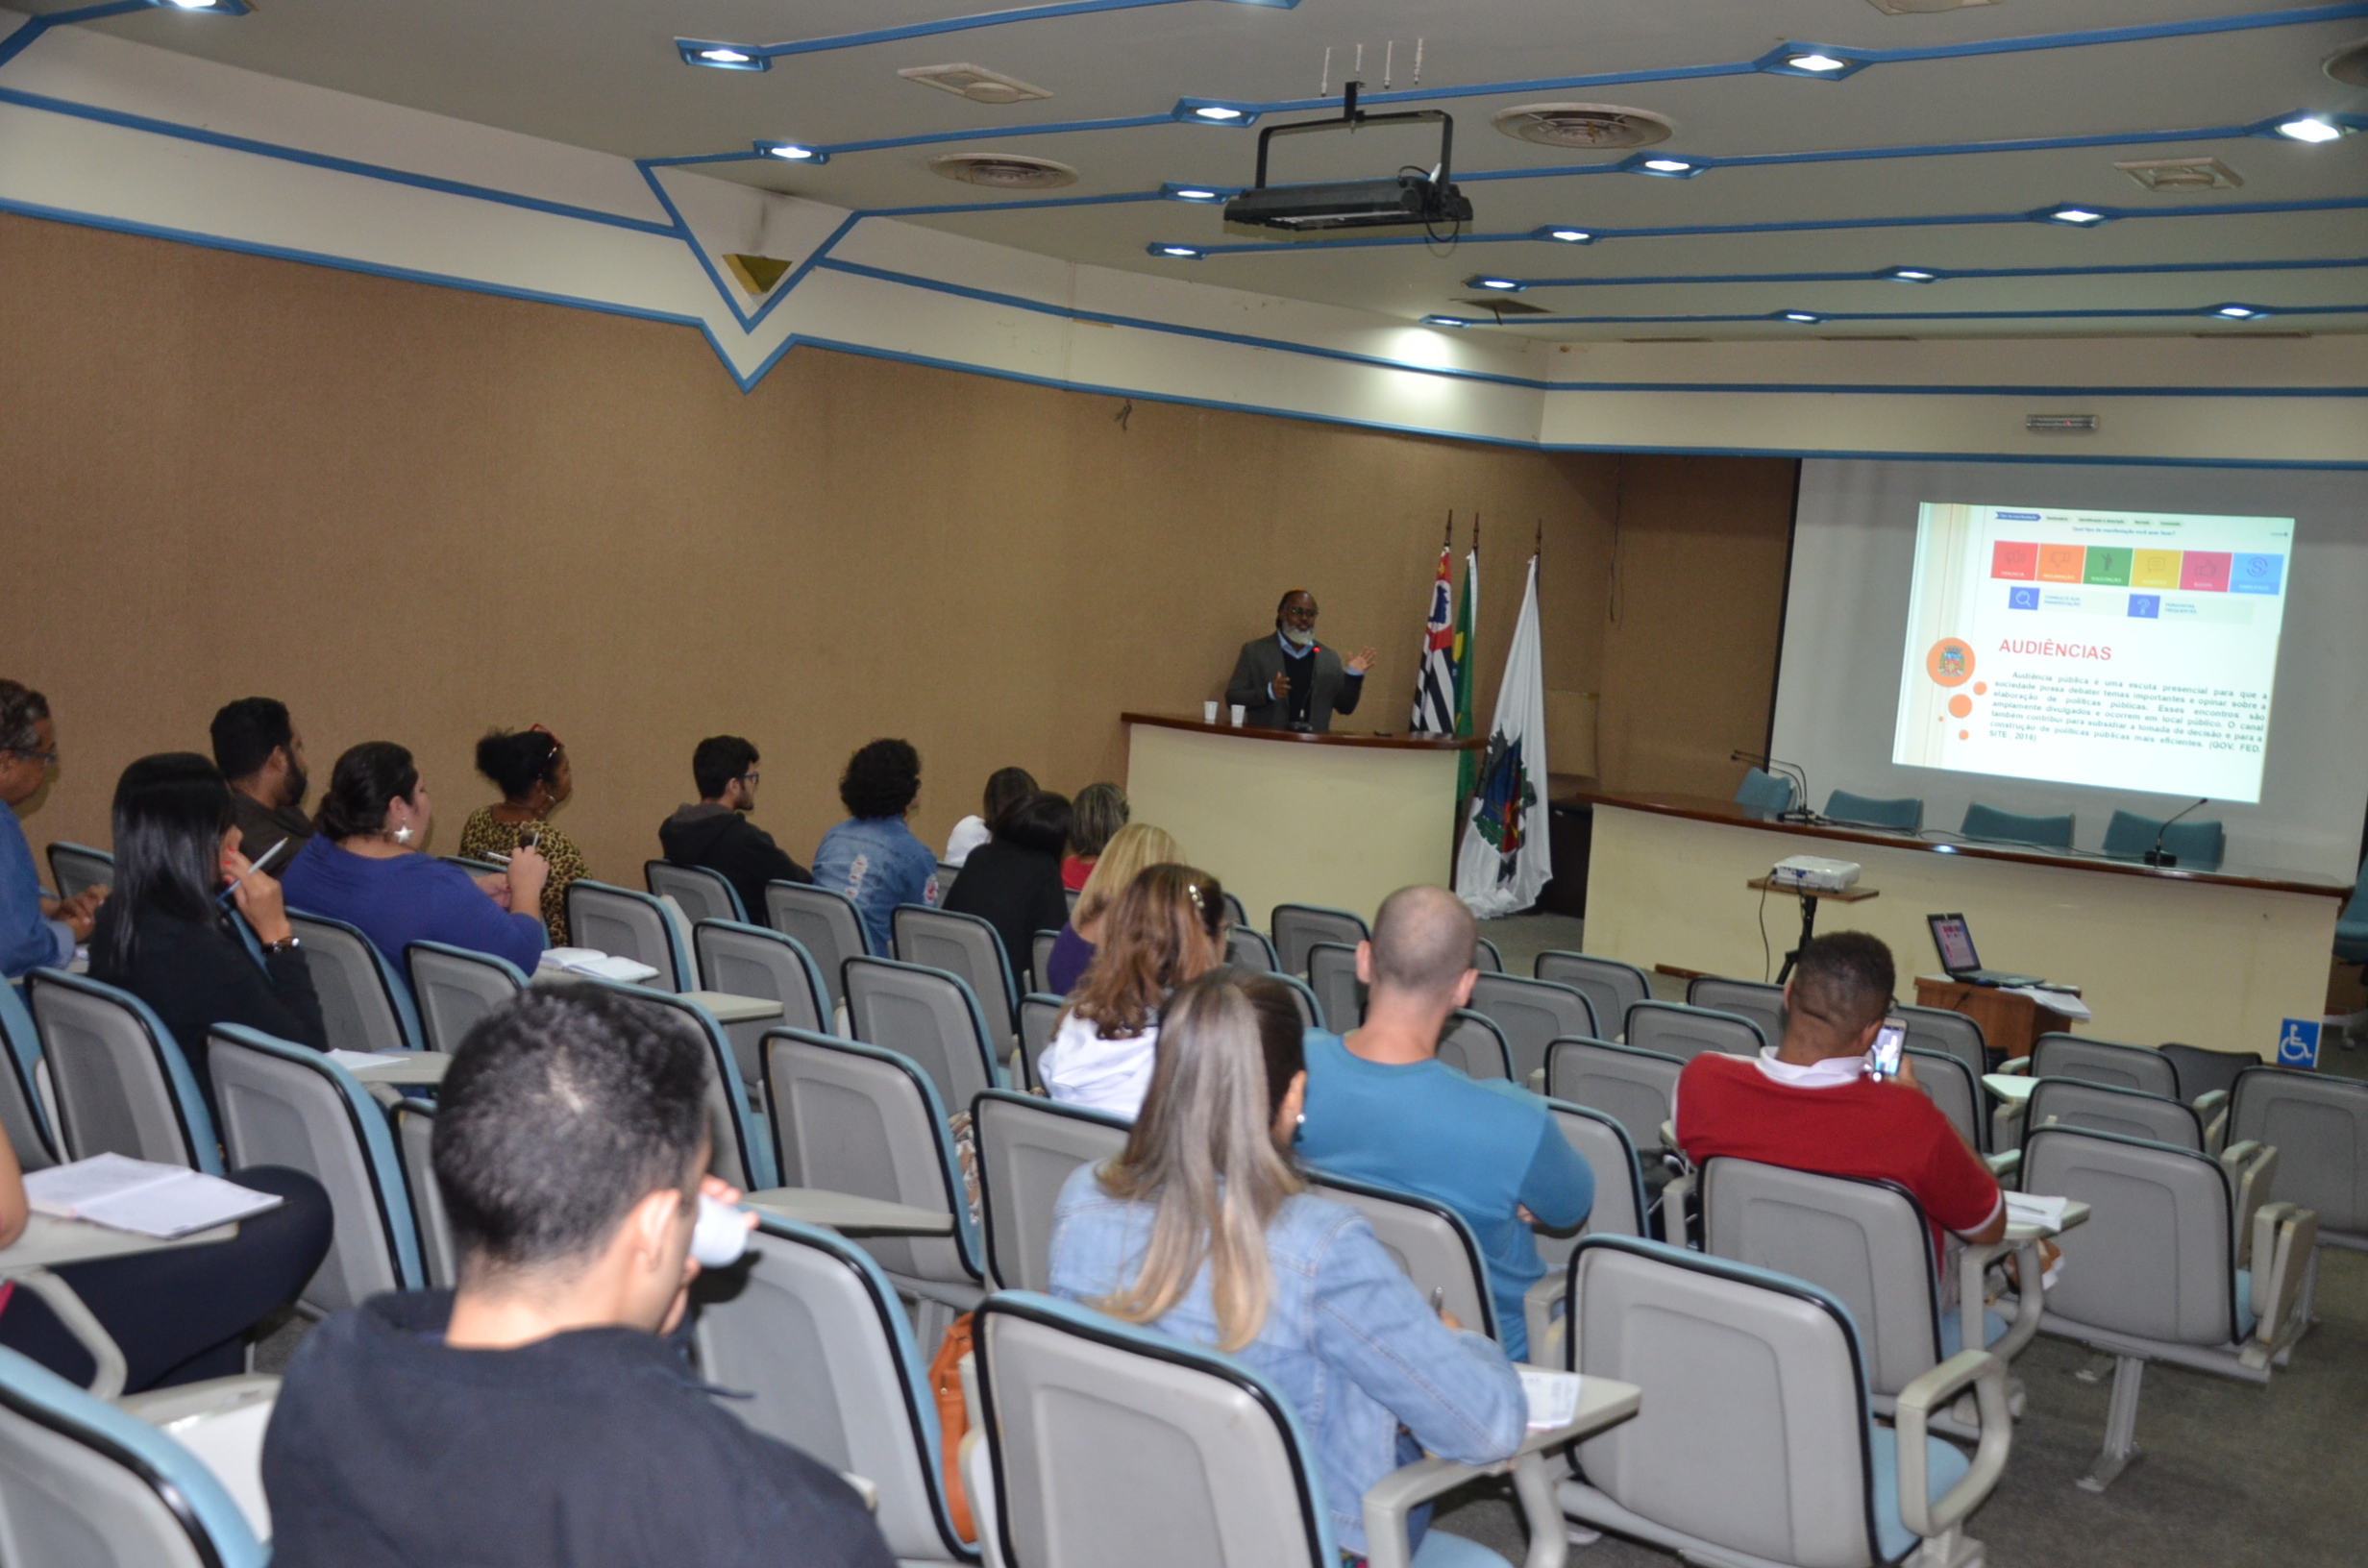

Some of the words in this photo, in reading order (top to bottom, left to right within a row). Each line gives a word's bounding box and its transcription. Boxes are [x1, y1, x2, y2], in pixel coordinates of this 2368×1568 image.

[1999, 638, 2112, 661] AUDIÊNCIAS
[1995, 681, 2035, 690] sociedade
[2068, 686, 2100, 696] debater
[2104, 690, 2130, 698] temas
[2134, 692, 2185, 702] importantes
[2012, 672, 2053, 681] Audiência
[2058, 675, 2088, 684] pública
[2162, 685, 2208, 694] presencial
[1992, 700, 2042, 710] amplamente
[2046, 705, 2091, 715] divulgados
[2187, 718, 2222, 727] público.
[1993, 691, 2038, 700] elaboração
[2065, 698, 2101, 706] políticas
[2110, 701, 2148, 710] públicas.
[2158, 704, 2184, 713] Esses
[2194, 709, 2239, 718] encontros
[1990, 721, 2035, 731] construção
[2054, 727, 2089, 736] políticas
[2094, 731, 2130, 740] públicas
[2159, 737, 2204, 747] eficientes.
[2209, 741, 2234, 750] (GOV.
[1991, 710, 2023, 719] também
[2027, 714, 2063, 723] contribui
[2088, 720, 2127, 729] subsidiar
[2138, 724, 2170, 733] tomada
[2187, 728, 2222, 738] decisão
[2014, 732, 2036, 742] 2018)
